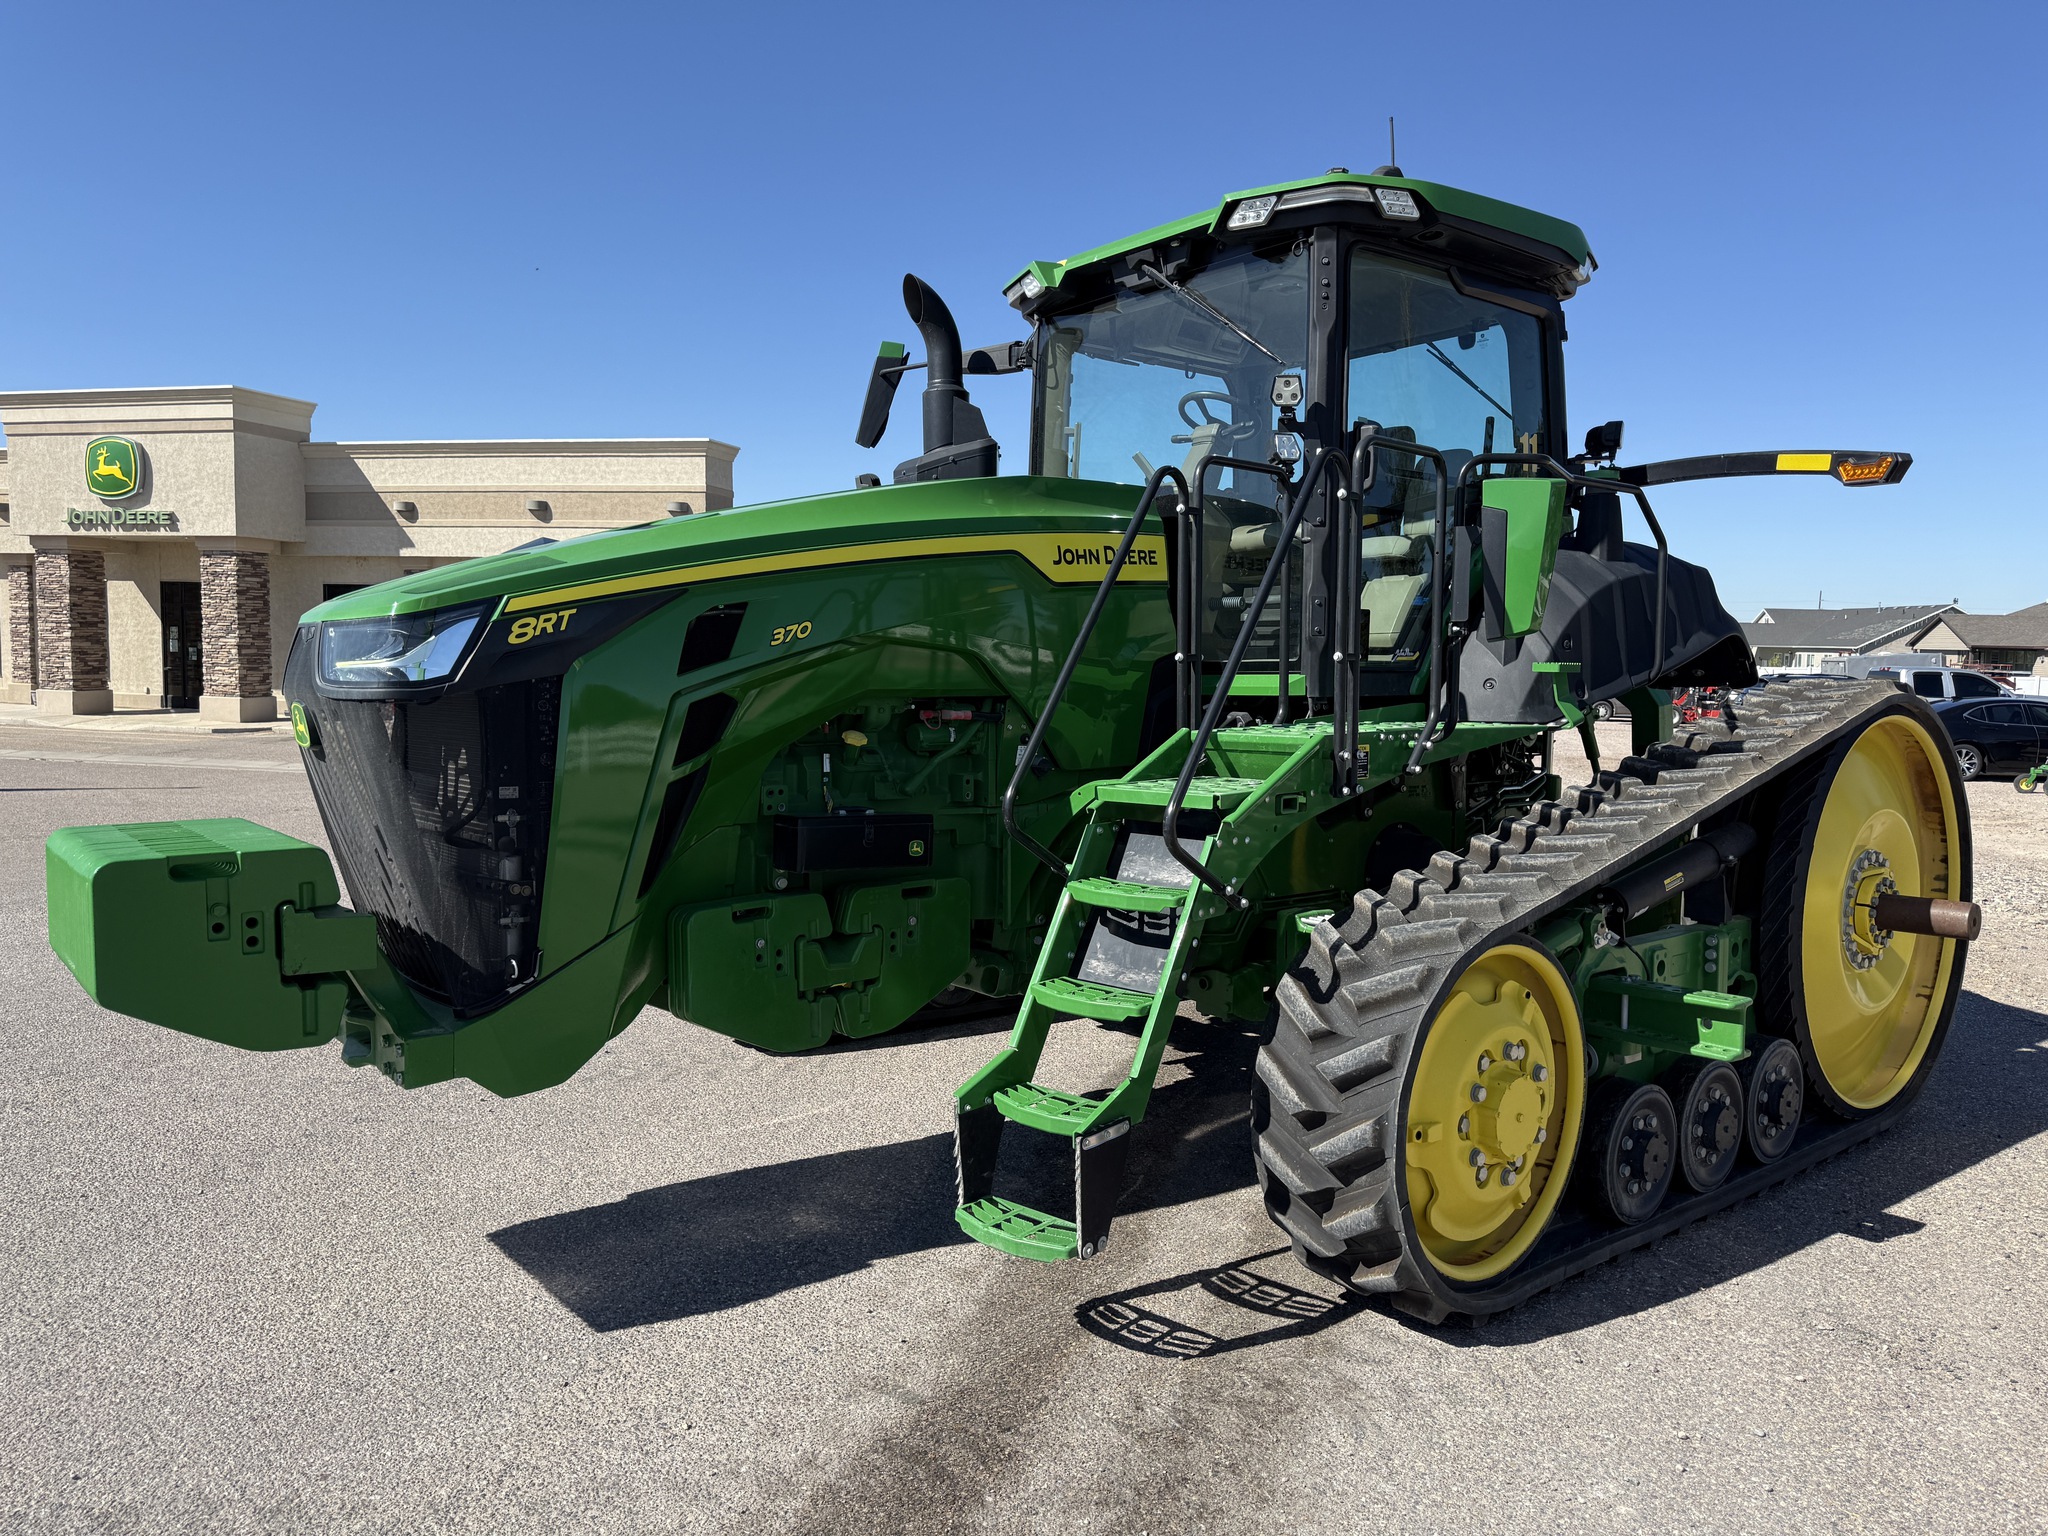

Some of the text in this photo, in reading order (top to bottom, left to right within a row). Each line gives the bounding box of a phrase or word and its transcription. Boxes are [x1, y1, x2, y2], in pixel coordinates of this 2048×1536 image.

[1520, 432, 1538, 472] 11
[62, 507, 171, 525] JOHN DEERE
[1053, 545, 1158, 565] JOHN DERE
[507, 608, 577, 644] 8RT
[770, 620, 812, 646] 370
